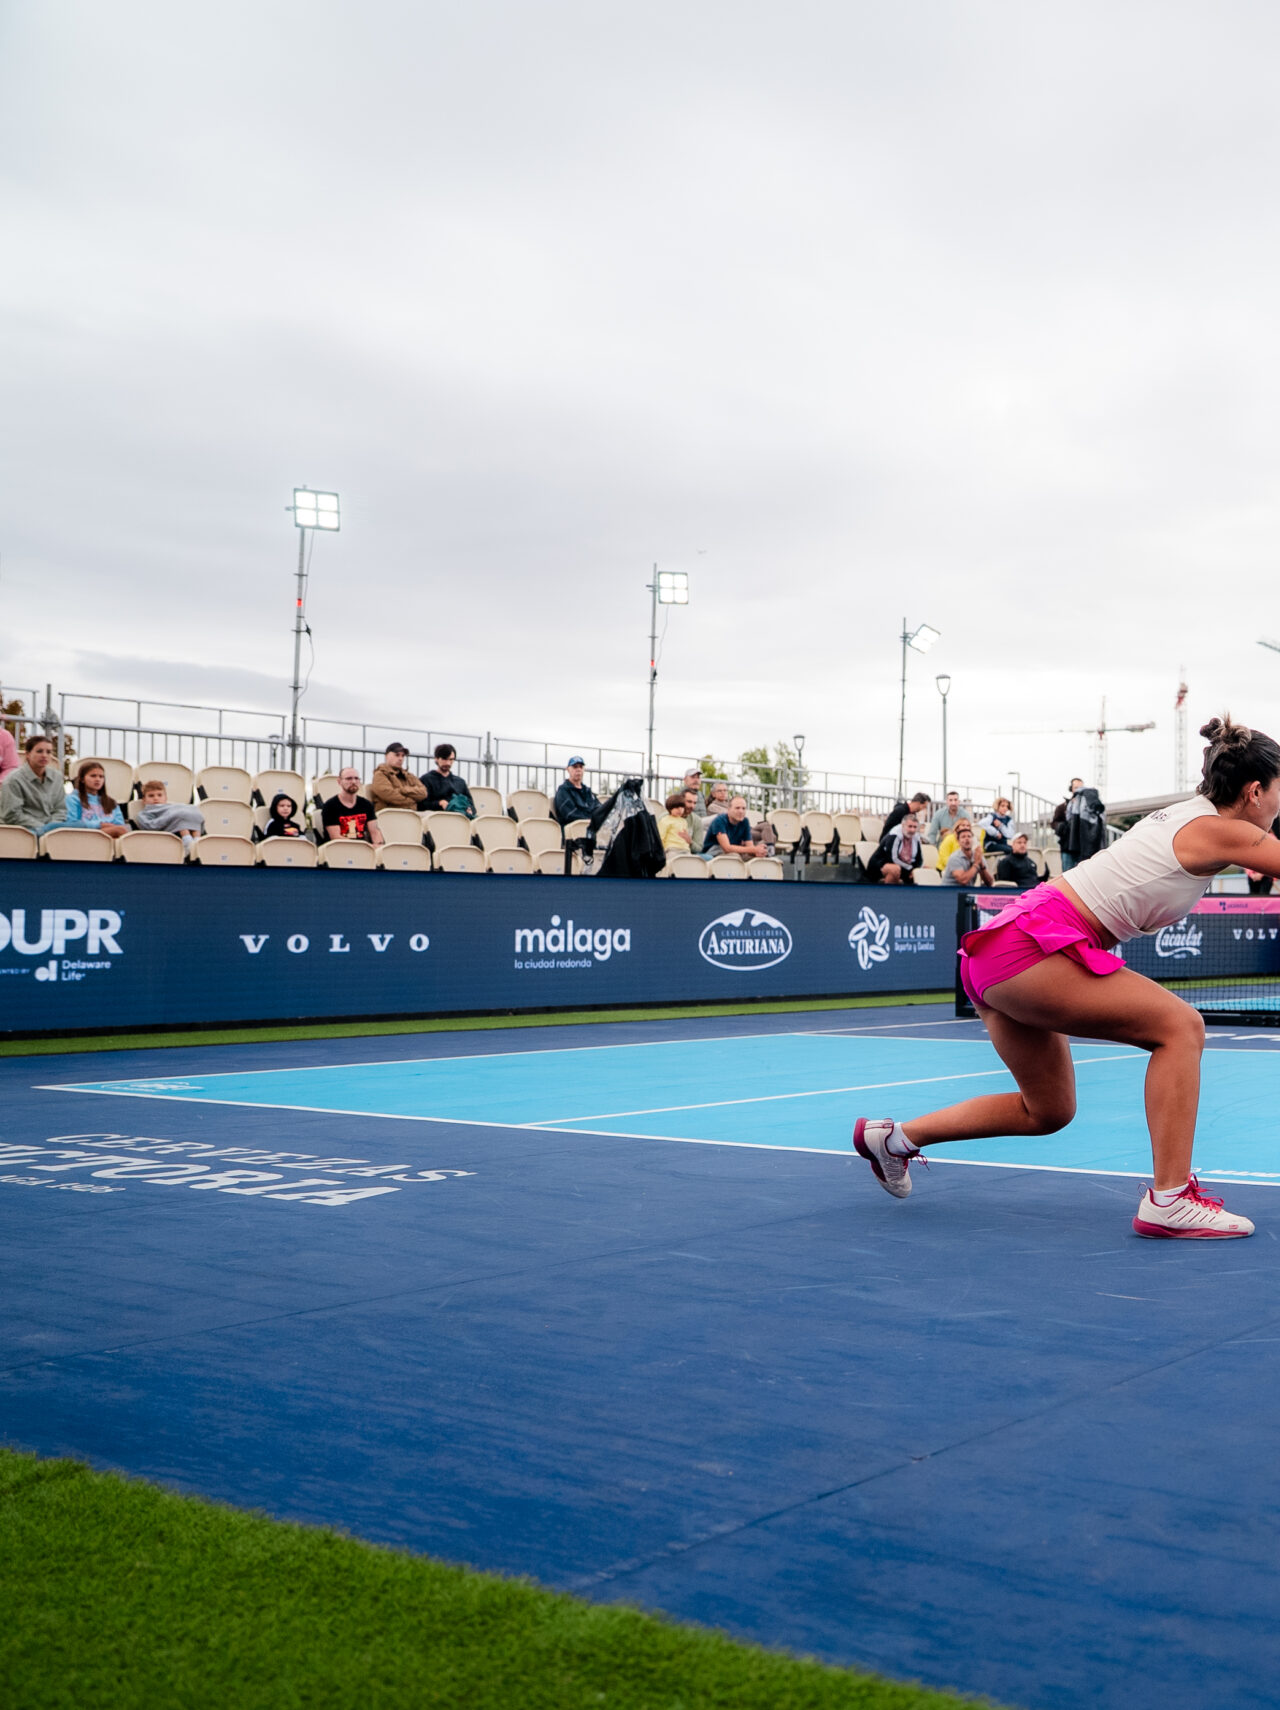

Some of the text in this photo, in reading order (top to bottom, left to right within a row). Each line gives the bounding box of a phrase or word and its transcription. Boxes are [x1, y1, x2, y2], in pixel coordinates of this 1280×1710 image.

[0, 909, 124, 955] UPR
[239, 933, 430, 954] VOLVO
[706, 931, 786, 955] ASTURIANA
[61, 959, 112, 970] Delaware
[514, 958, 592, 969] la ciudad redonda
[61, 971, 82, 981] Life
[46, 1133, 478, 1182] CERVEZAS
